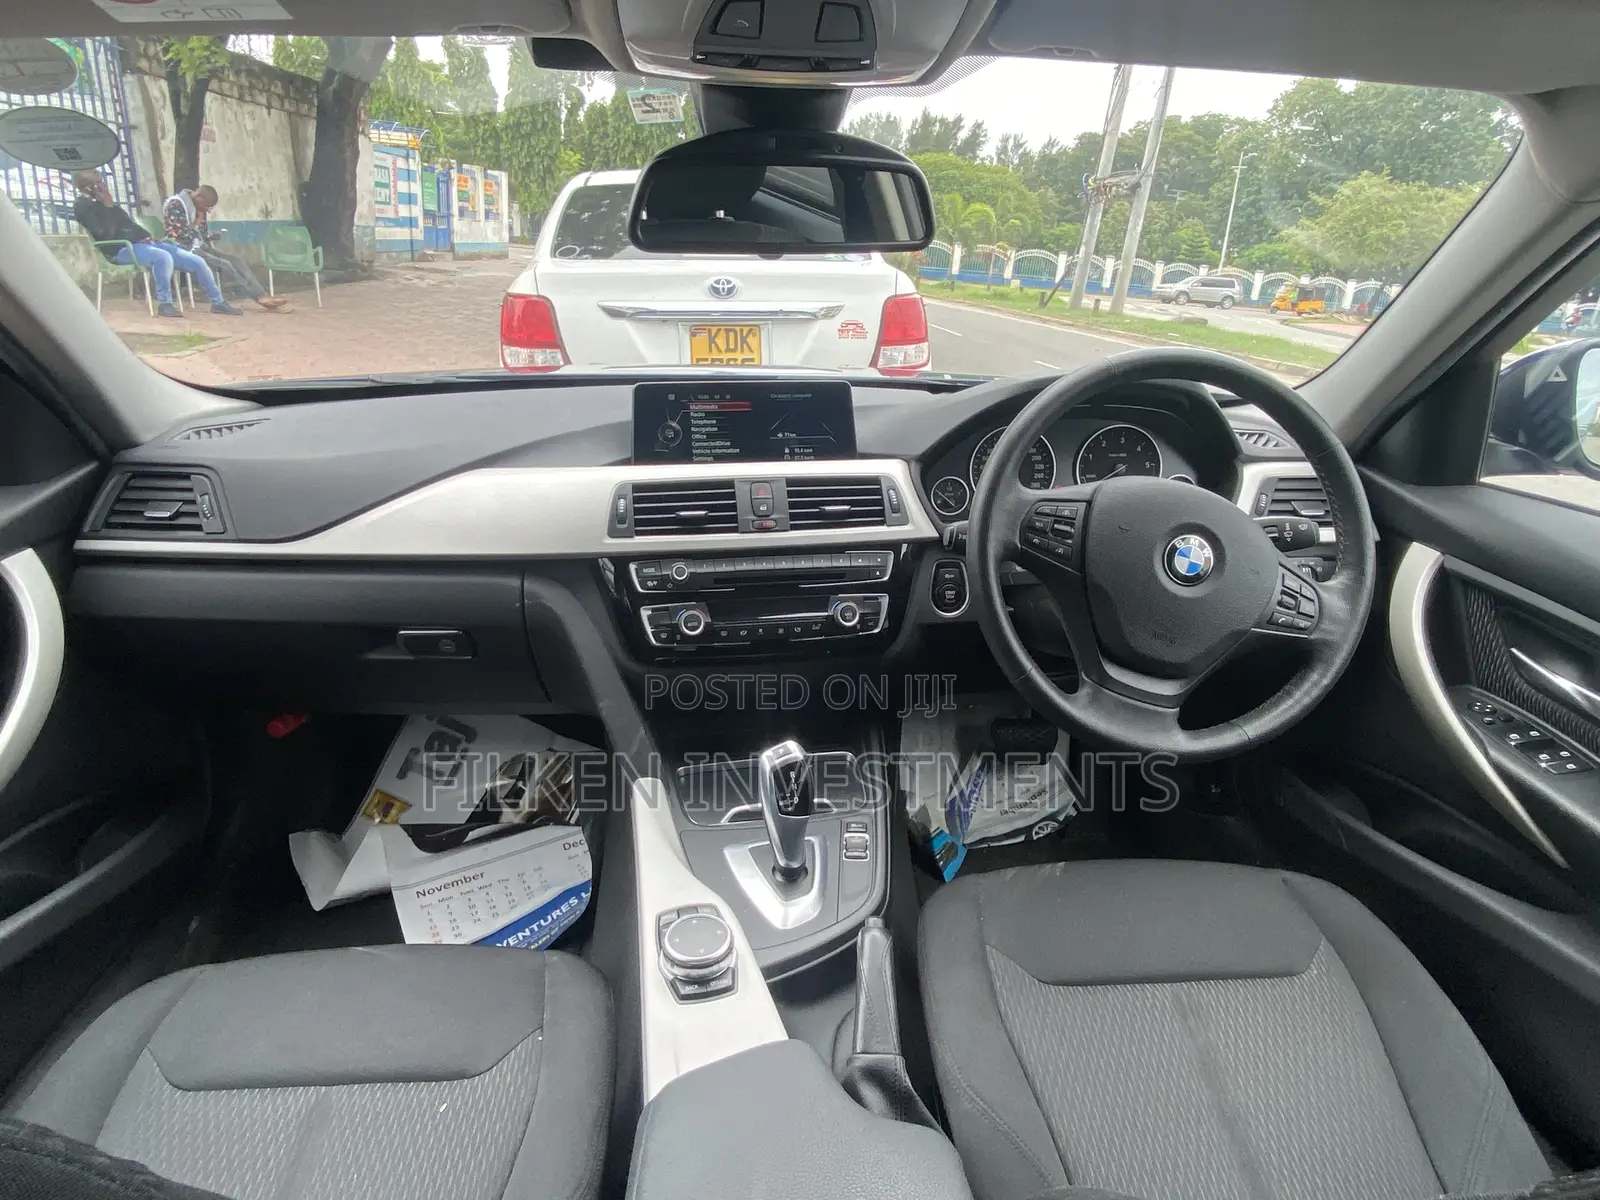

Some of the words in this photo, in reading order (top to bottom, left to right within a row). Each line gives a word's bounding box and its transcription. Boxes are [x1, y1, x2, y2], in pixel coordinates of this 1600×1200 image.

[708, 328, 754, 354] KDK
[1174, 538, 1210, 558] BMW
[562, 839, 586, 851] Dec
[415, 872, 485, 899] November
[477, 882, 493, 890] Wed
[496, 896, 579, 947] VENTURES
